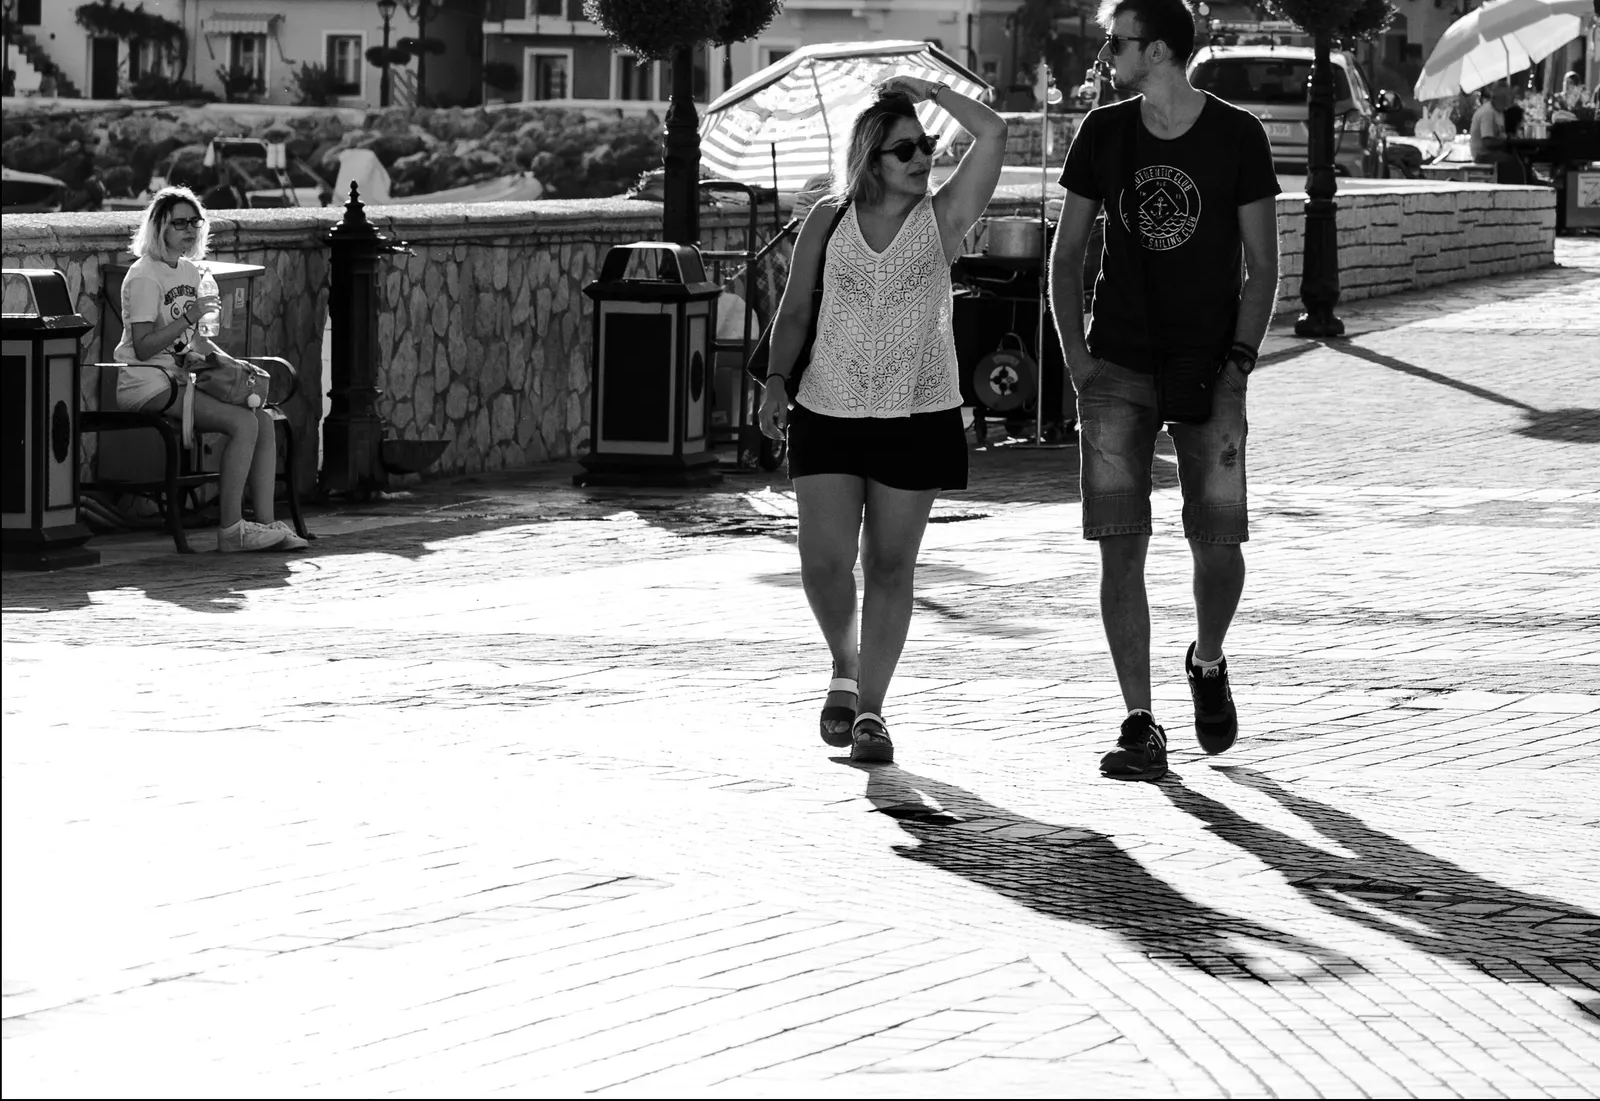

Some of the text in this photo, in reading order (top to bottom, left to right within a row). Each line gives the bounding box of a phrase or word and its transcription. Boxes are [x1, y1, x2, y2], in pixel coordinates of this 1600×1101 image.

[1134, 168, 1193, 192] UTHENTIC CLUB
[1148, 215, 1197, 249] SAILING CLUB
